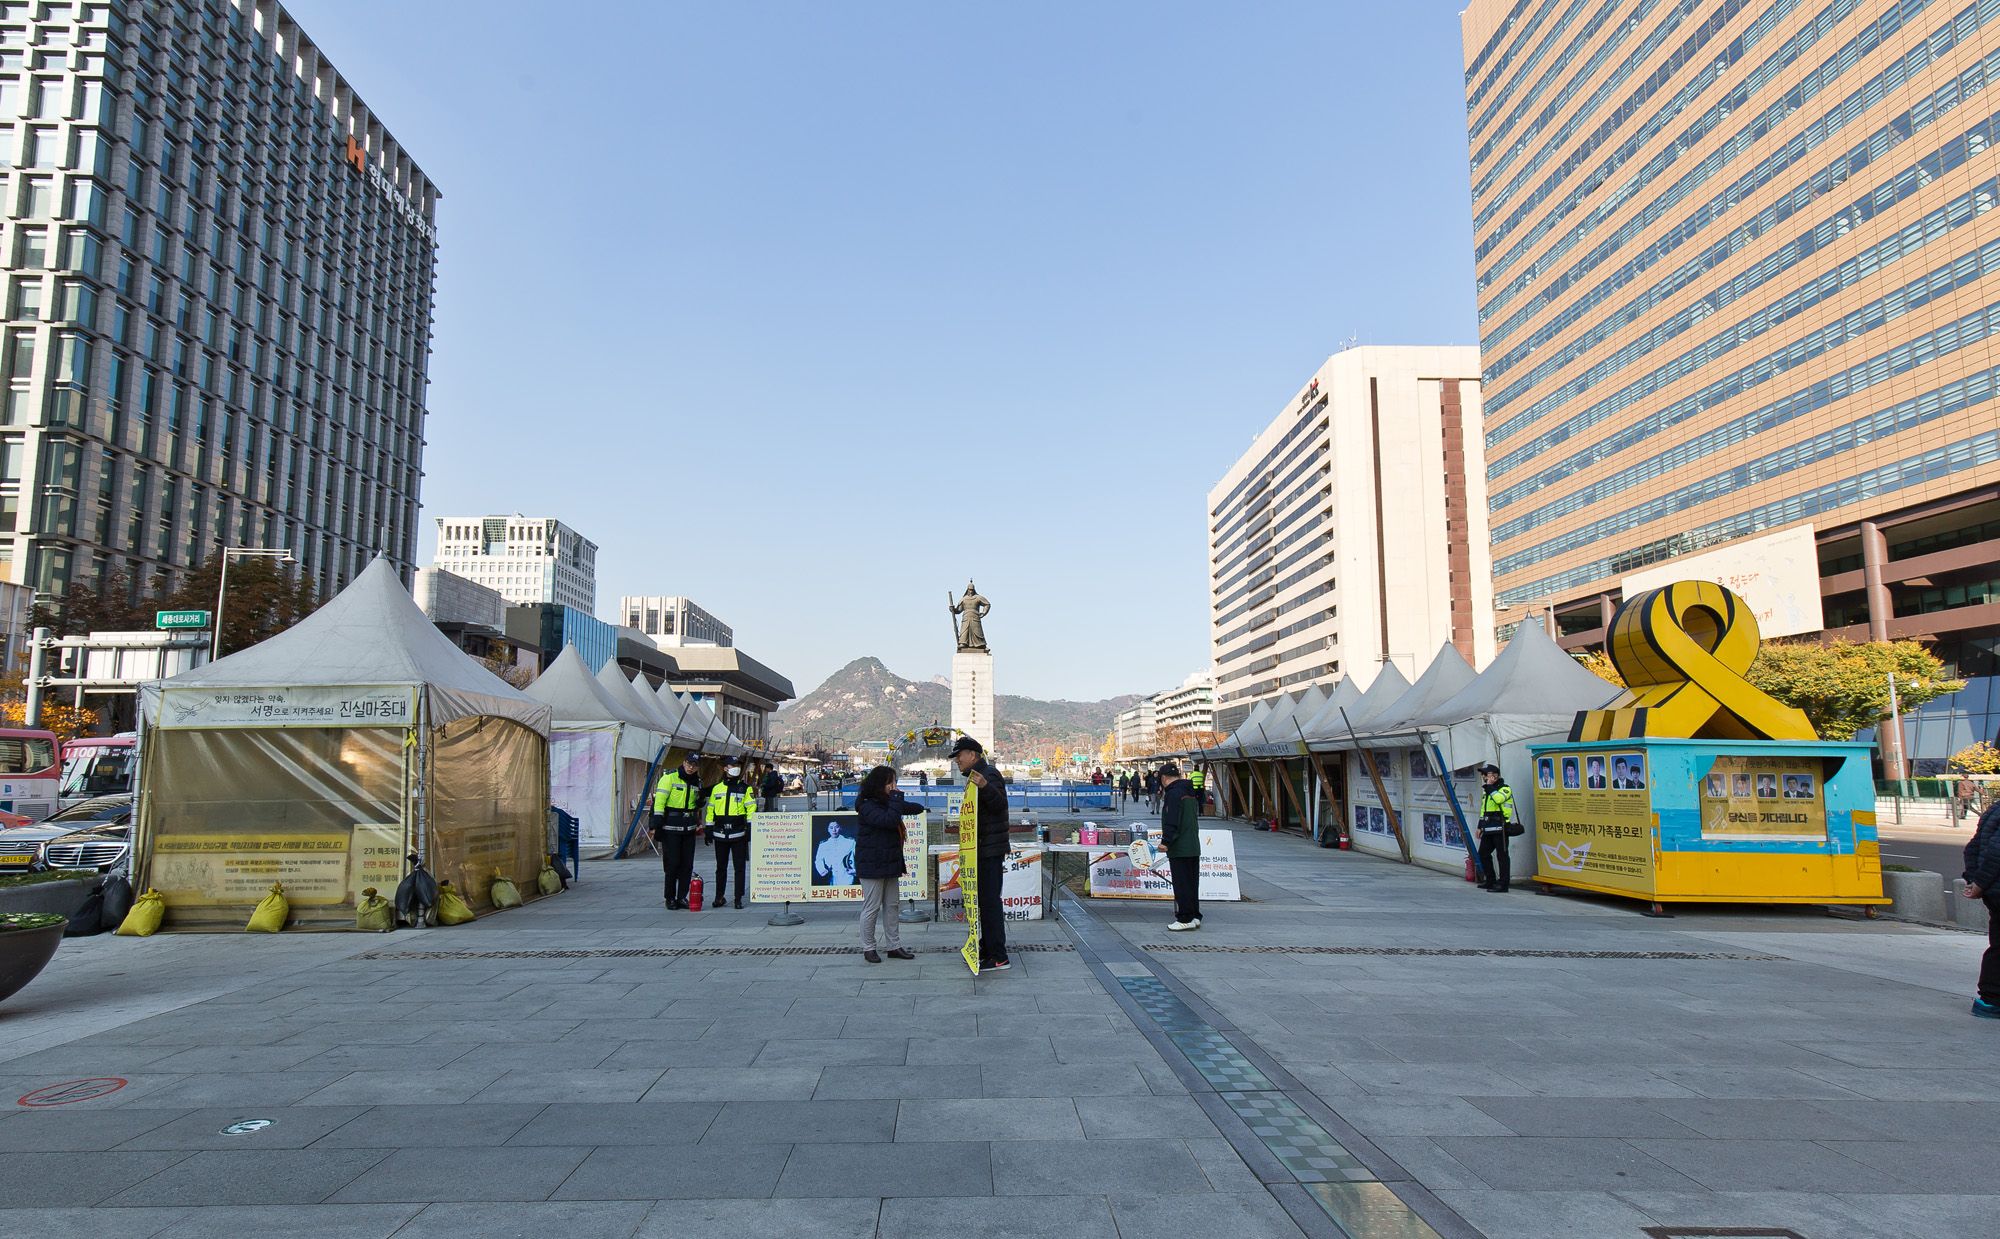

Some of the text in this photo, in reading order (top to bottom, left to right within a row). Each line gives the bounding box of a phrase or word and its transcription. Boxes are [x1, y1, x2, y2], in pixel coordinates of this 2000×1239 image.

[162, 614, 200, 624] 세종대로사거리
[214, 695, 286, 704] 잊지 않겠다는 약속.
[251, 704, 334, 717] 서명으로 지켜주세요!
[340, 700, 406, 718] 진실마중대
[65, 748, 96, 758] 1100
[1728, 812, 1808, 823] 당신을 기다립니다
[1542, 821, 1643, 838] 마지막 한분까지 가족품으로!
[378, 848, 400, 856] 특조위
[1097, 868, 1121, 877] 정부는
[362, 874, 382, 882] 진실을
[1108, 880, 1141, 889] 사고원인
[811, 889, 839, 898] 보고싶다
[1001, 896, 1042, 907] 데이지호
